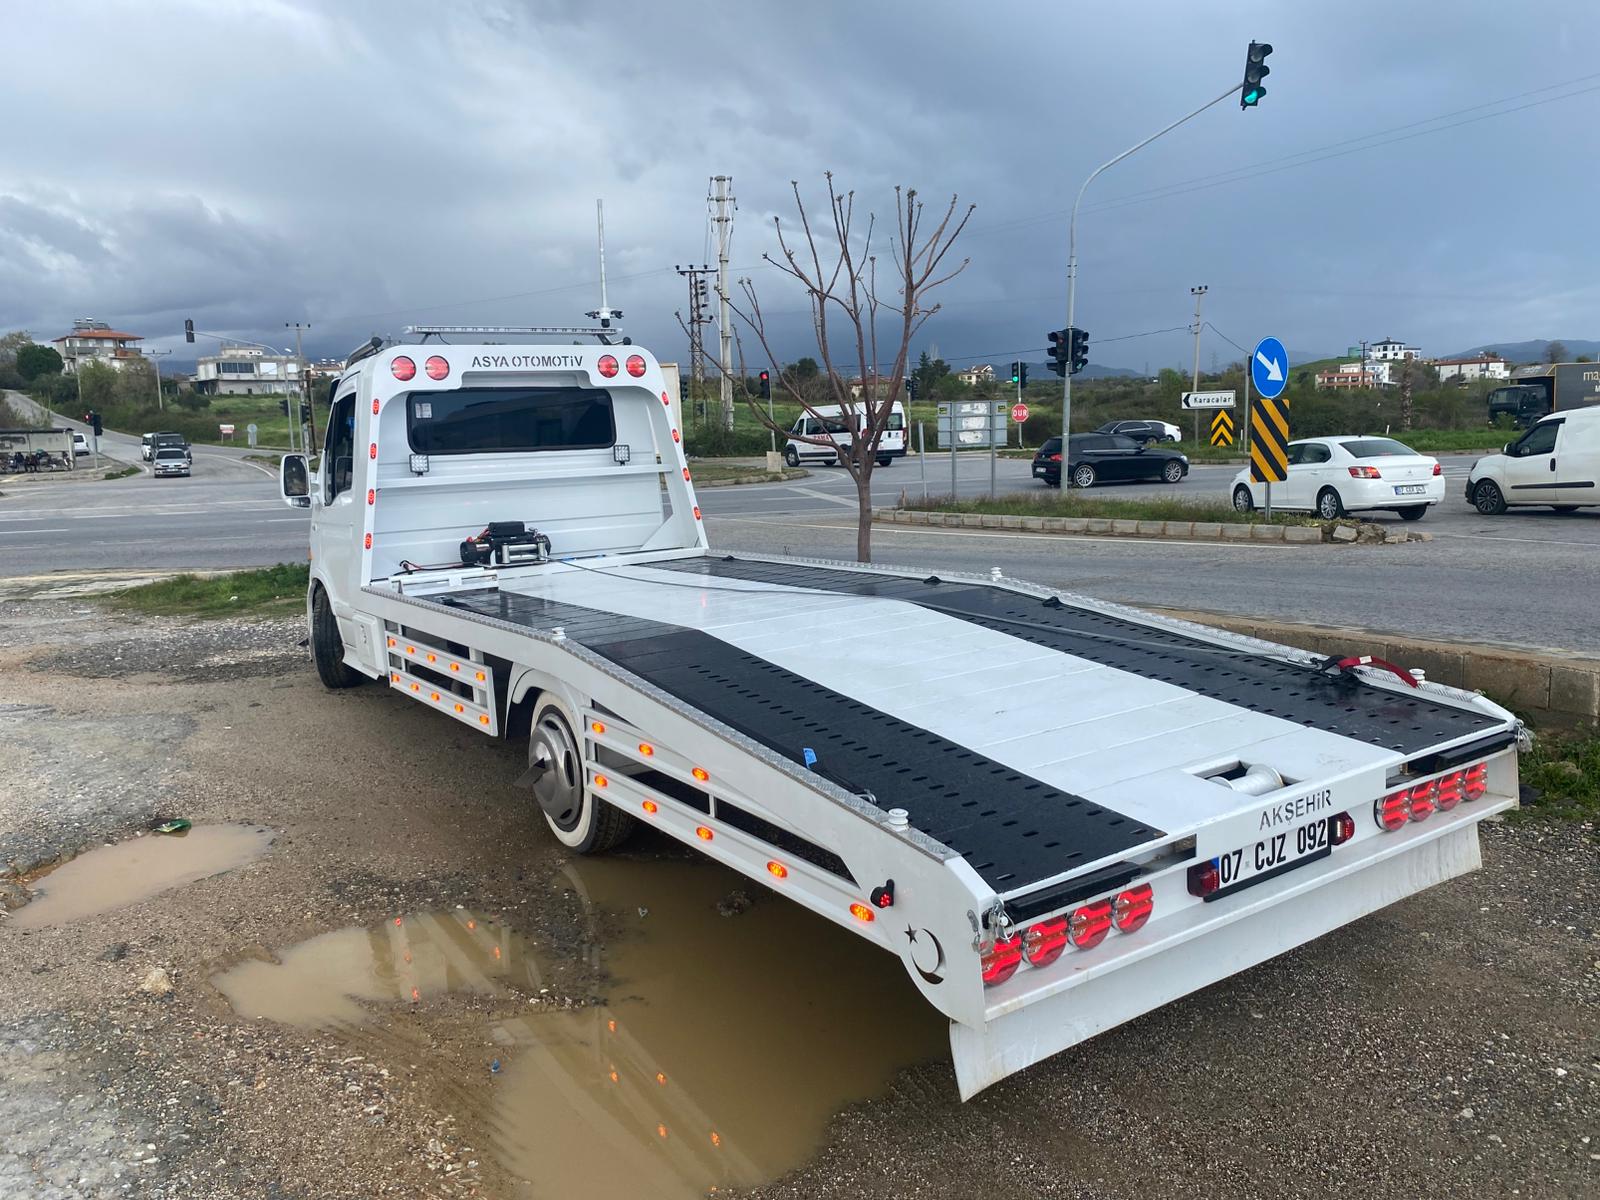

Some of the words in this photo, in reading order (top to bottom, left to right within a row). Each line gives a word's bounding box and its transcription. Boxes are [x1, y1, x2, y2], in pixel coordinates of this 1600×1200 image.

[471, 356, 509, 368] ASYA
[1194, 396, 1231, 404] Karacalar
[1013, 409, 1027, 417] DUR
[1220, 848, 1243, 884] 07
[1254, 832, 1287, 871] CJZ
[1297, 818, 1327, 854] 092
